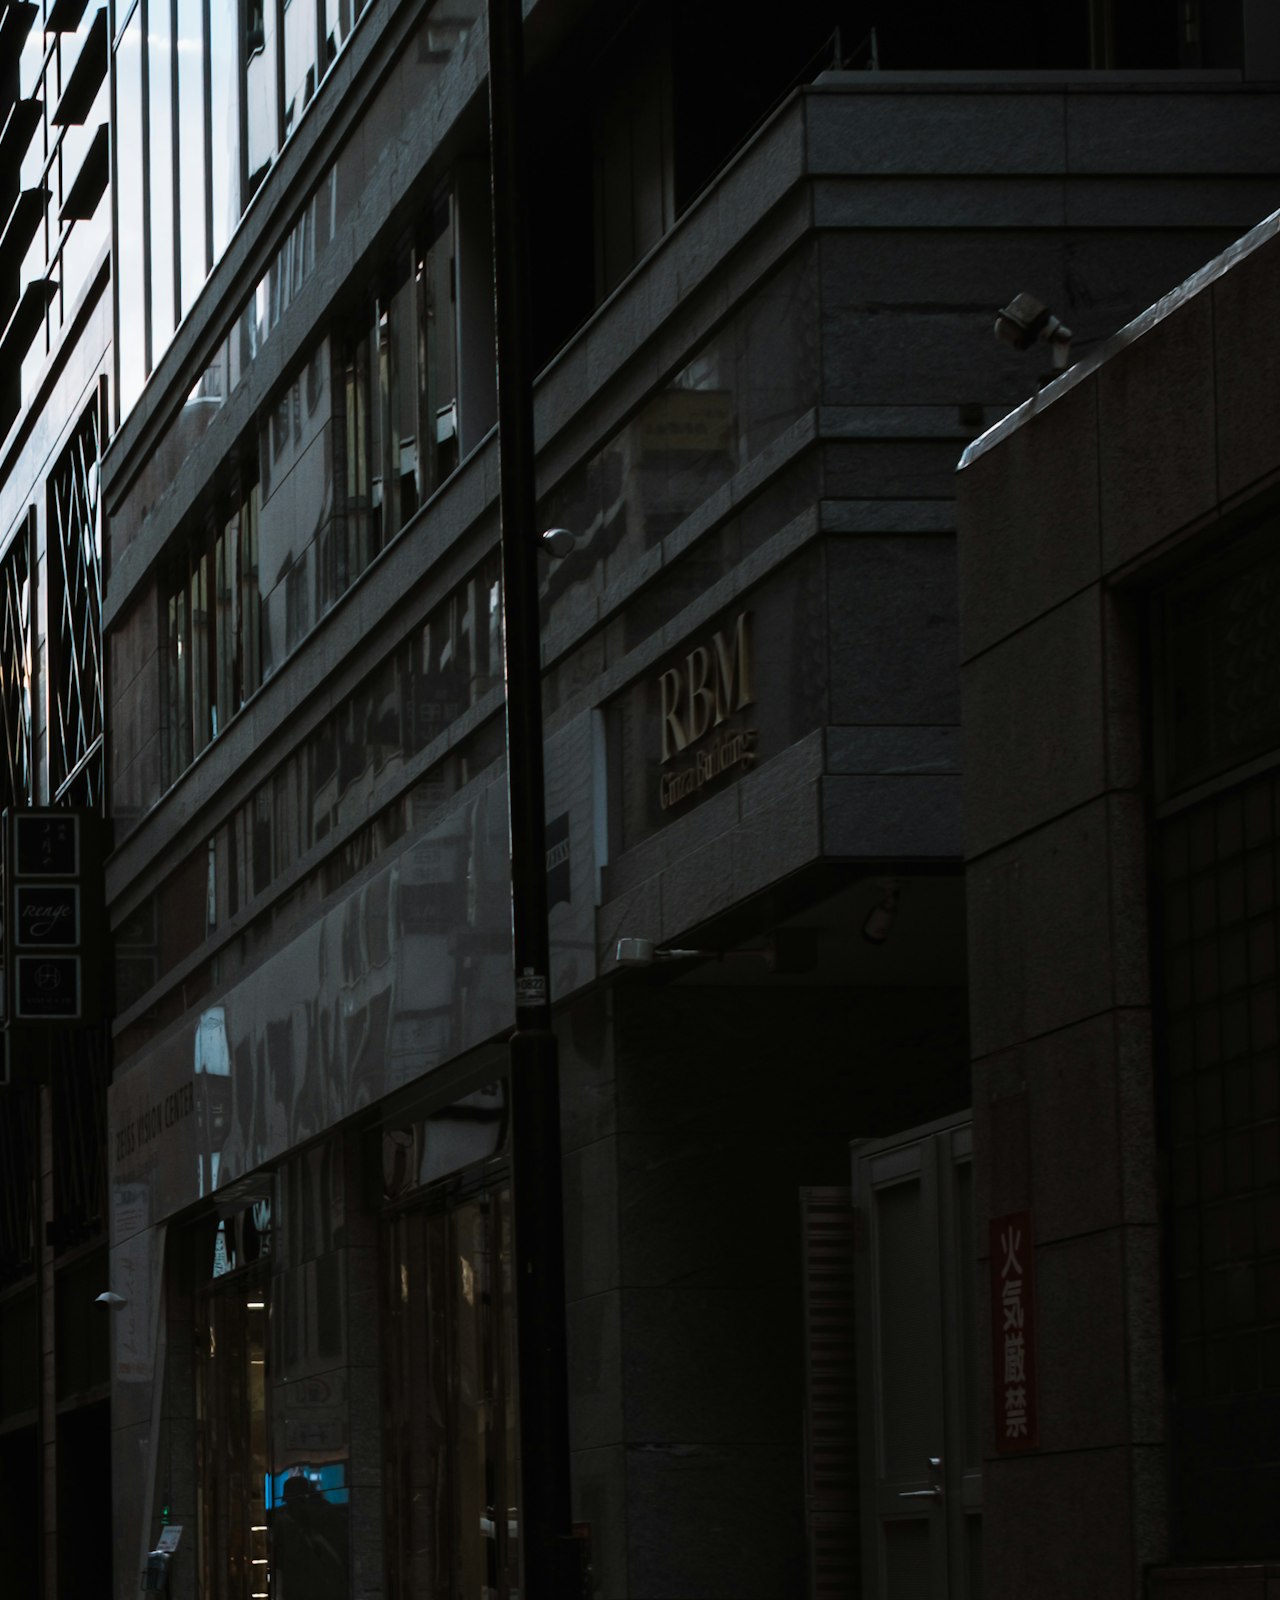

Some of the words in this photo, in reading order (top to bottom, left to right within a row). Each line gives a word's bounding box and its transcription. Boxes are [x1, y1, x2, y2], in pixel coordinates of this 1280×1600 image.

[659, 611, 757, 766] RBM
[660, 768, 697, 811] Ginza
[696, 728, 758, 787] Building
[1001, 1225, 1029, 1439] 火気厳禁
